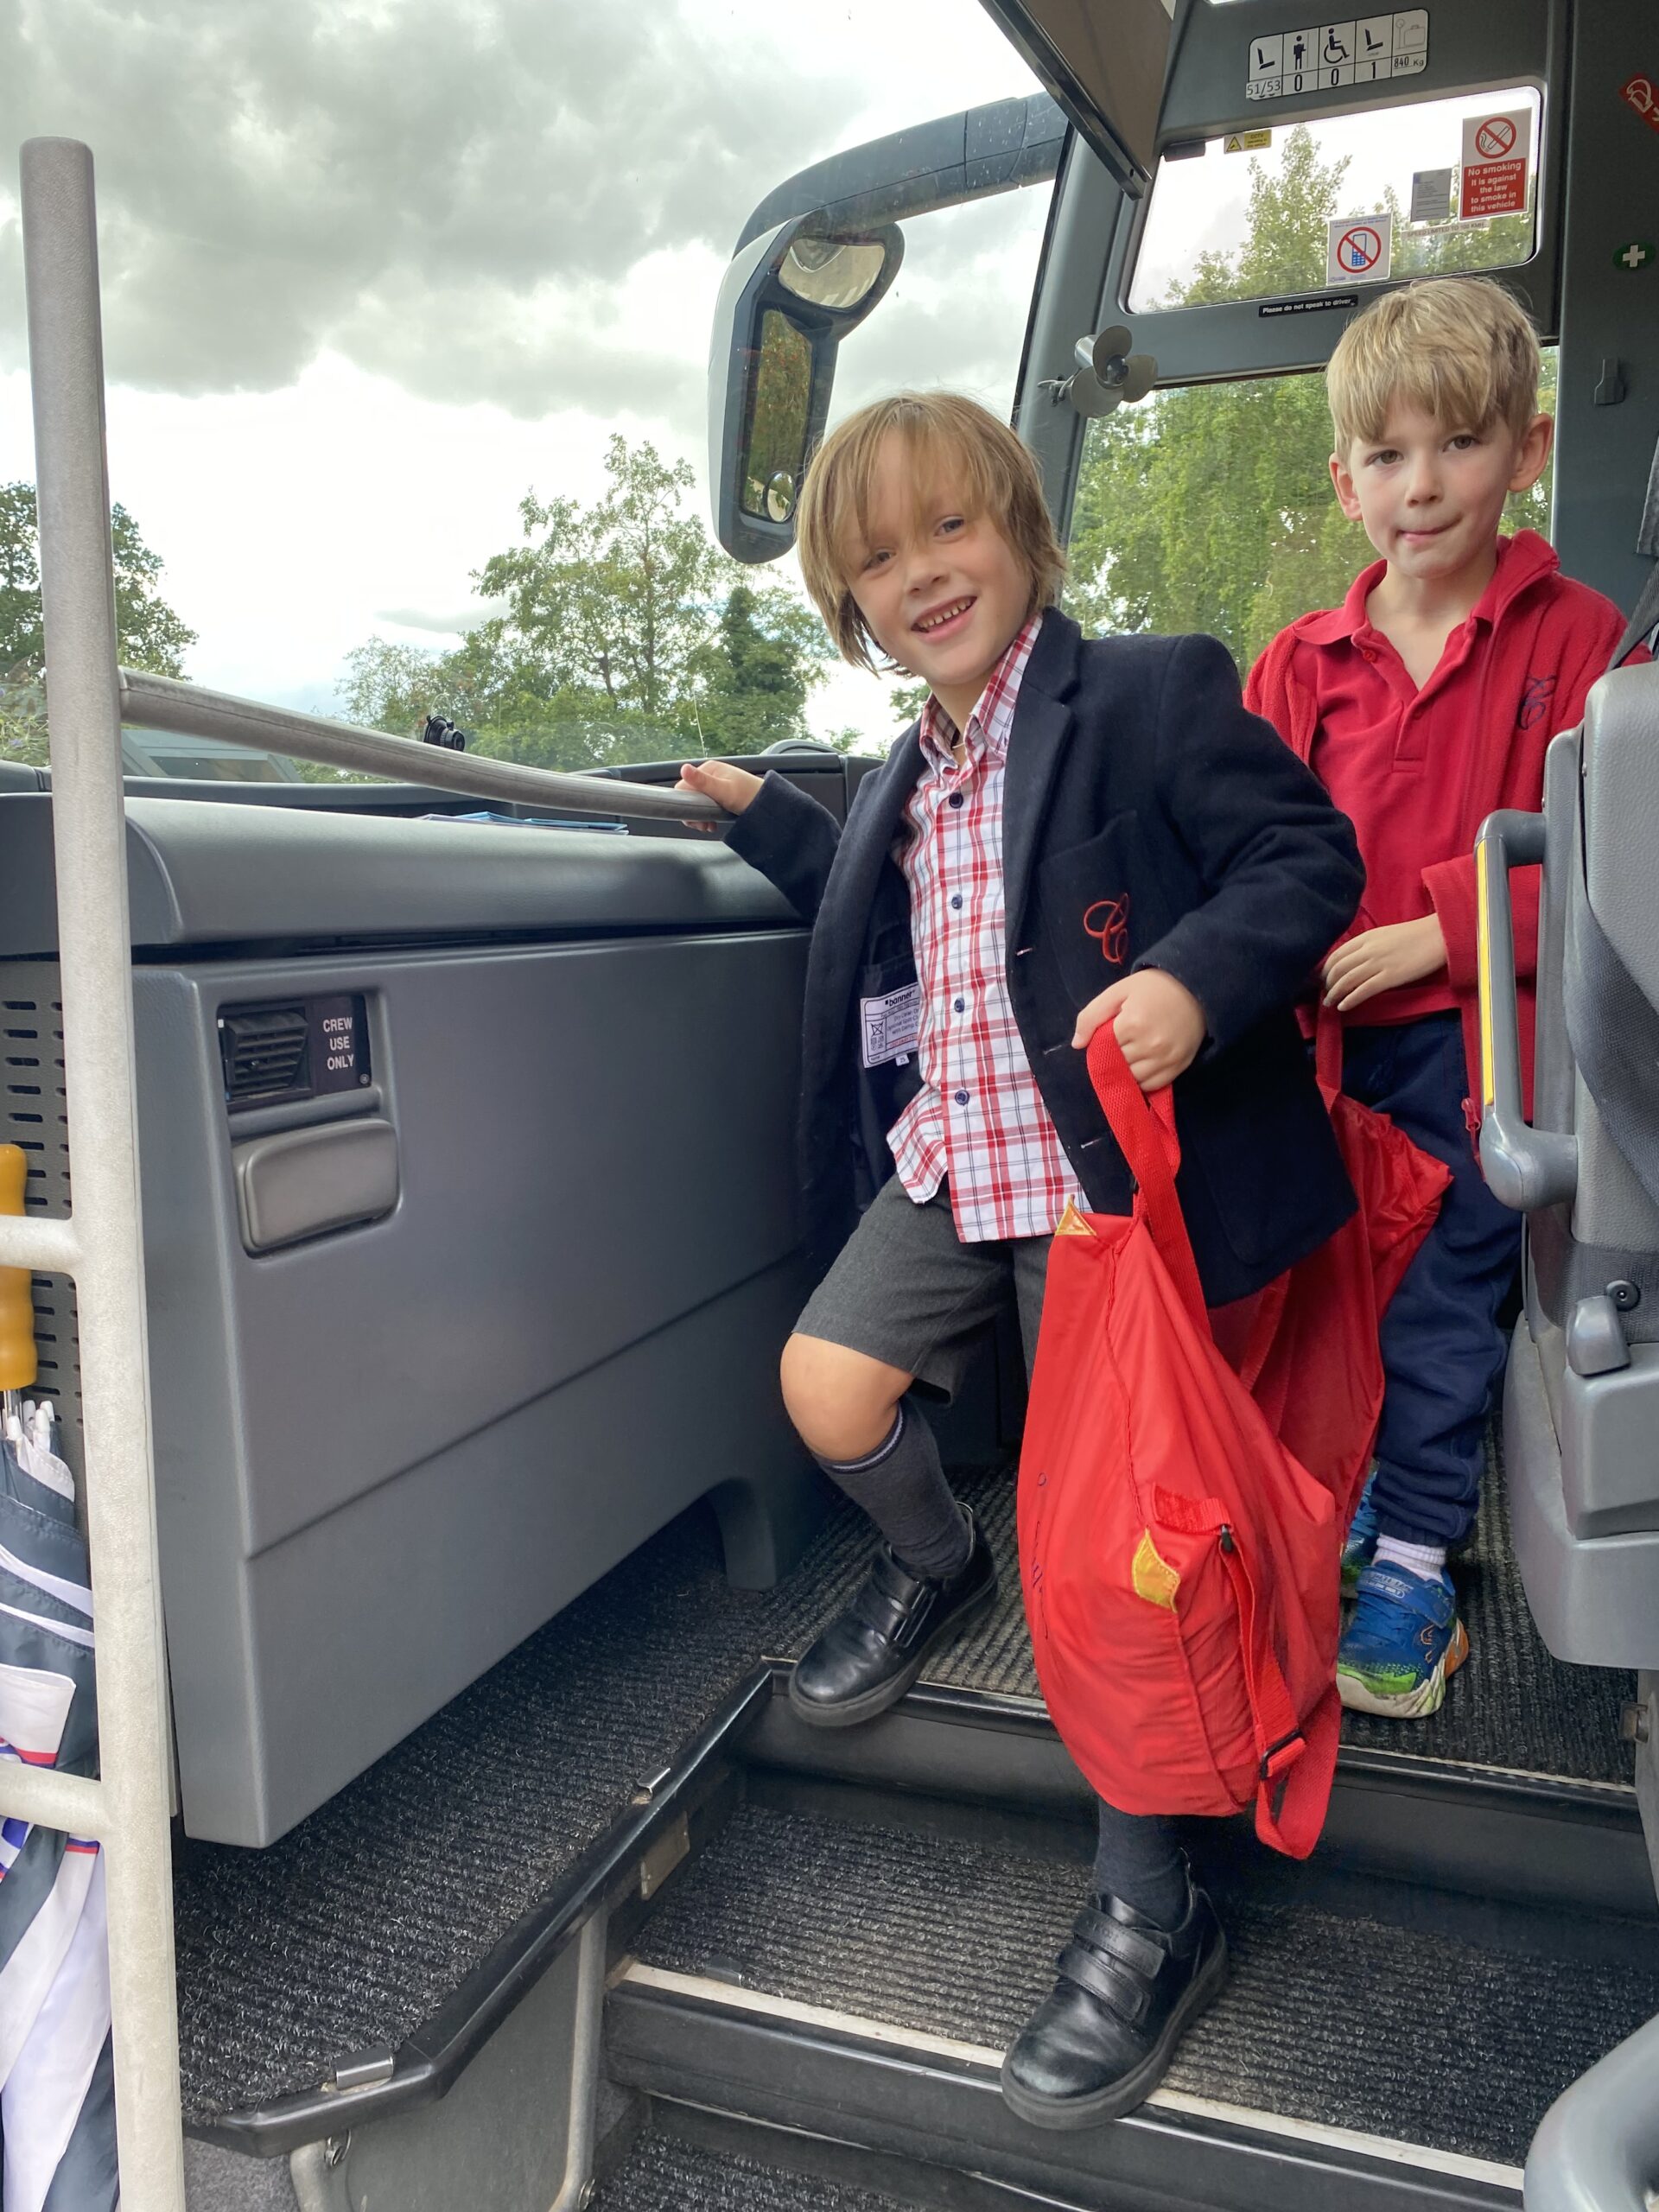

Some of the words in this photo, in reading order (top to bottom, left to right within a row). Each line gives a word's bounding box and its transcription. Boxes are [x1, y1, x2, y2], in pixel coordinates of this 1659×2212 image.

[1247, 79, 1281, 96] 51/53
[1294, 73, 1303, 92] 0
[1331, 67, 1339, 86] 0
[1371, 61, 1376, 79] 1
[1394, 56, 1409, 68] 840
[1413, 59, 1424, 68] Kg
[1467, 168, 1481, 177] No
[1483, 162, 1522, 175] smoking
[1487, 173, 1516, 185] against
[1479, 186, 1492, 194] the
[1480, 193, 1507, 203] smoke
[1471, 204, 1485, 213] this
[1487, 200, 1516, 210] vehicle
[1427, 226, 1450, 235] LIMITED
[1305, 301, 1324, 309] speak
[889, 991, 912, 1007] banner
[322, 1016, 353, 1033] CREW
[329, 1036, 350, 1051] USE
[327, 1054, 354, 1071] ONLY
